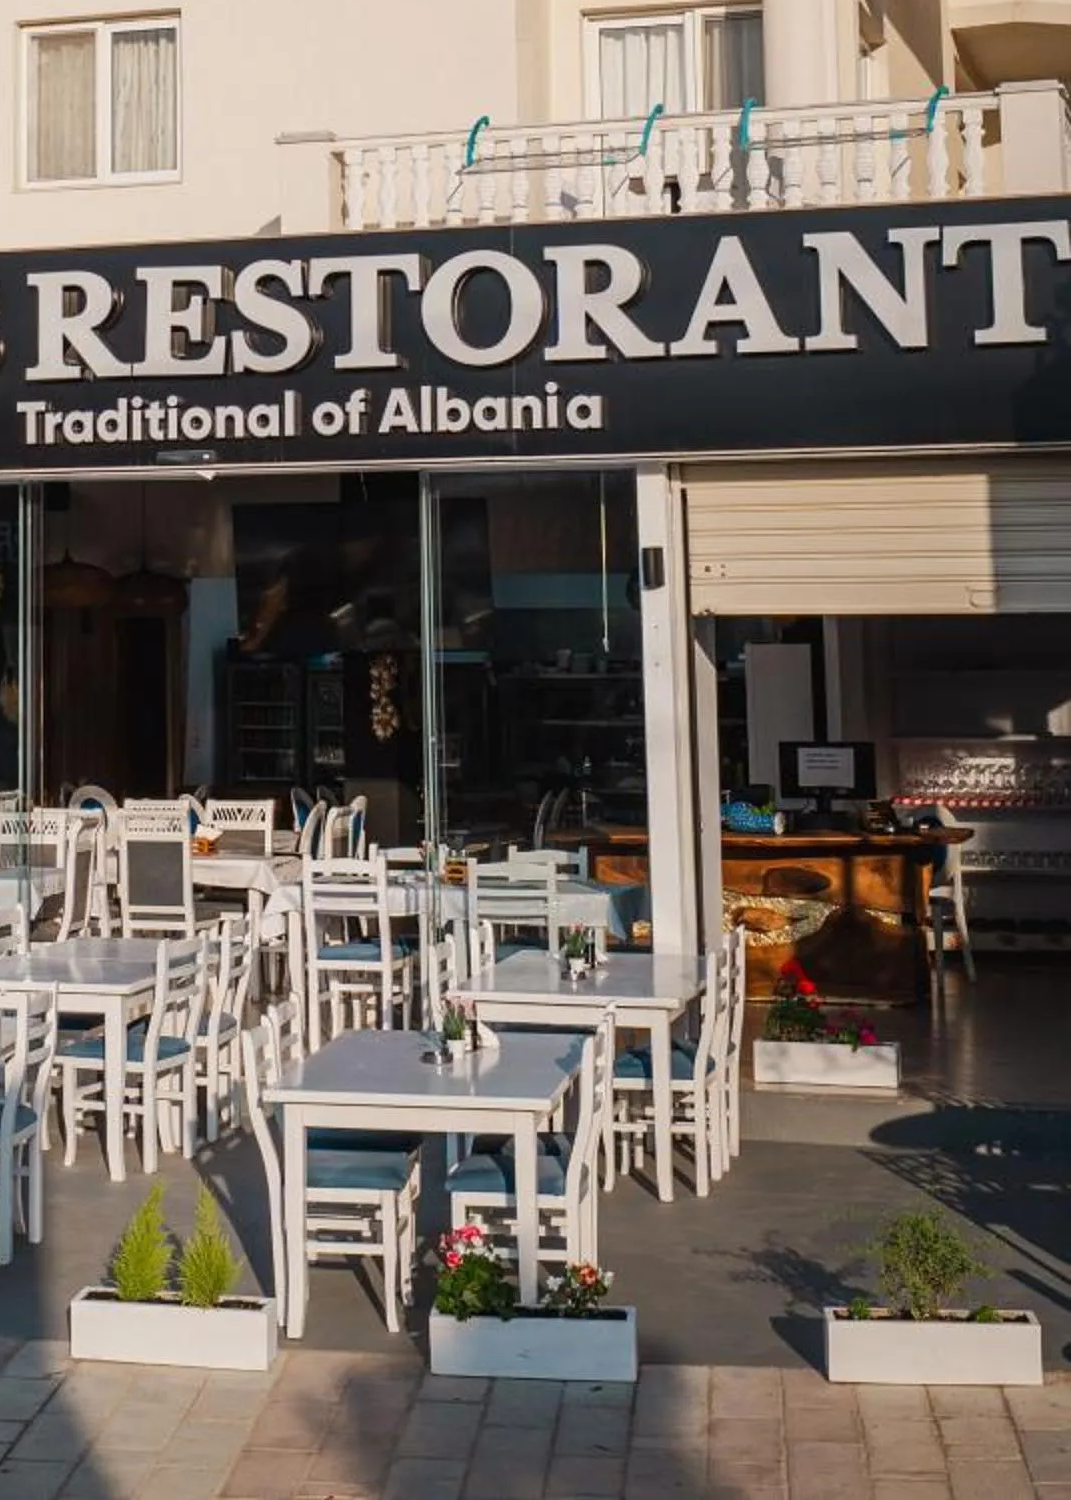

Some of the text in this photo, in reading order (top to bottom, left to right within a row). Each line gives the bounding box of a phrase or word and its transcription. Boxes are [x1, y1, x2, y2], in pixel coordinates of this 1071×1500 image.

[25, 219, 1071, 382] RESTORANT
[17, 382, 604, 445] Traditional of Albania
